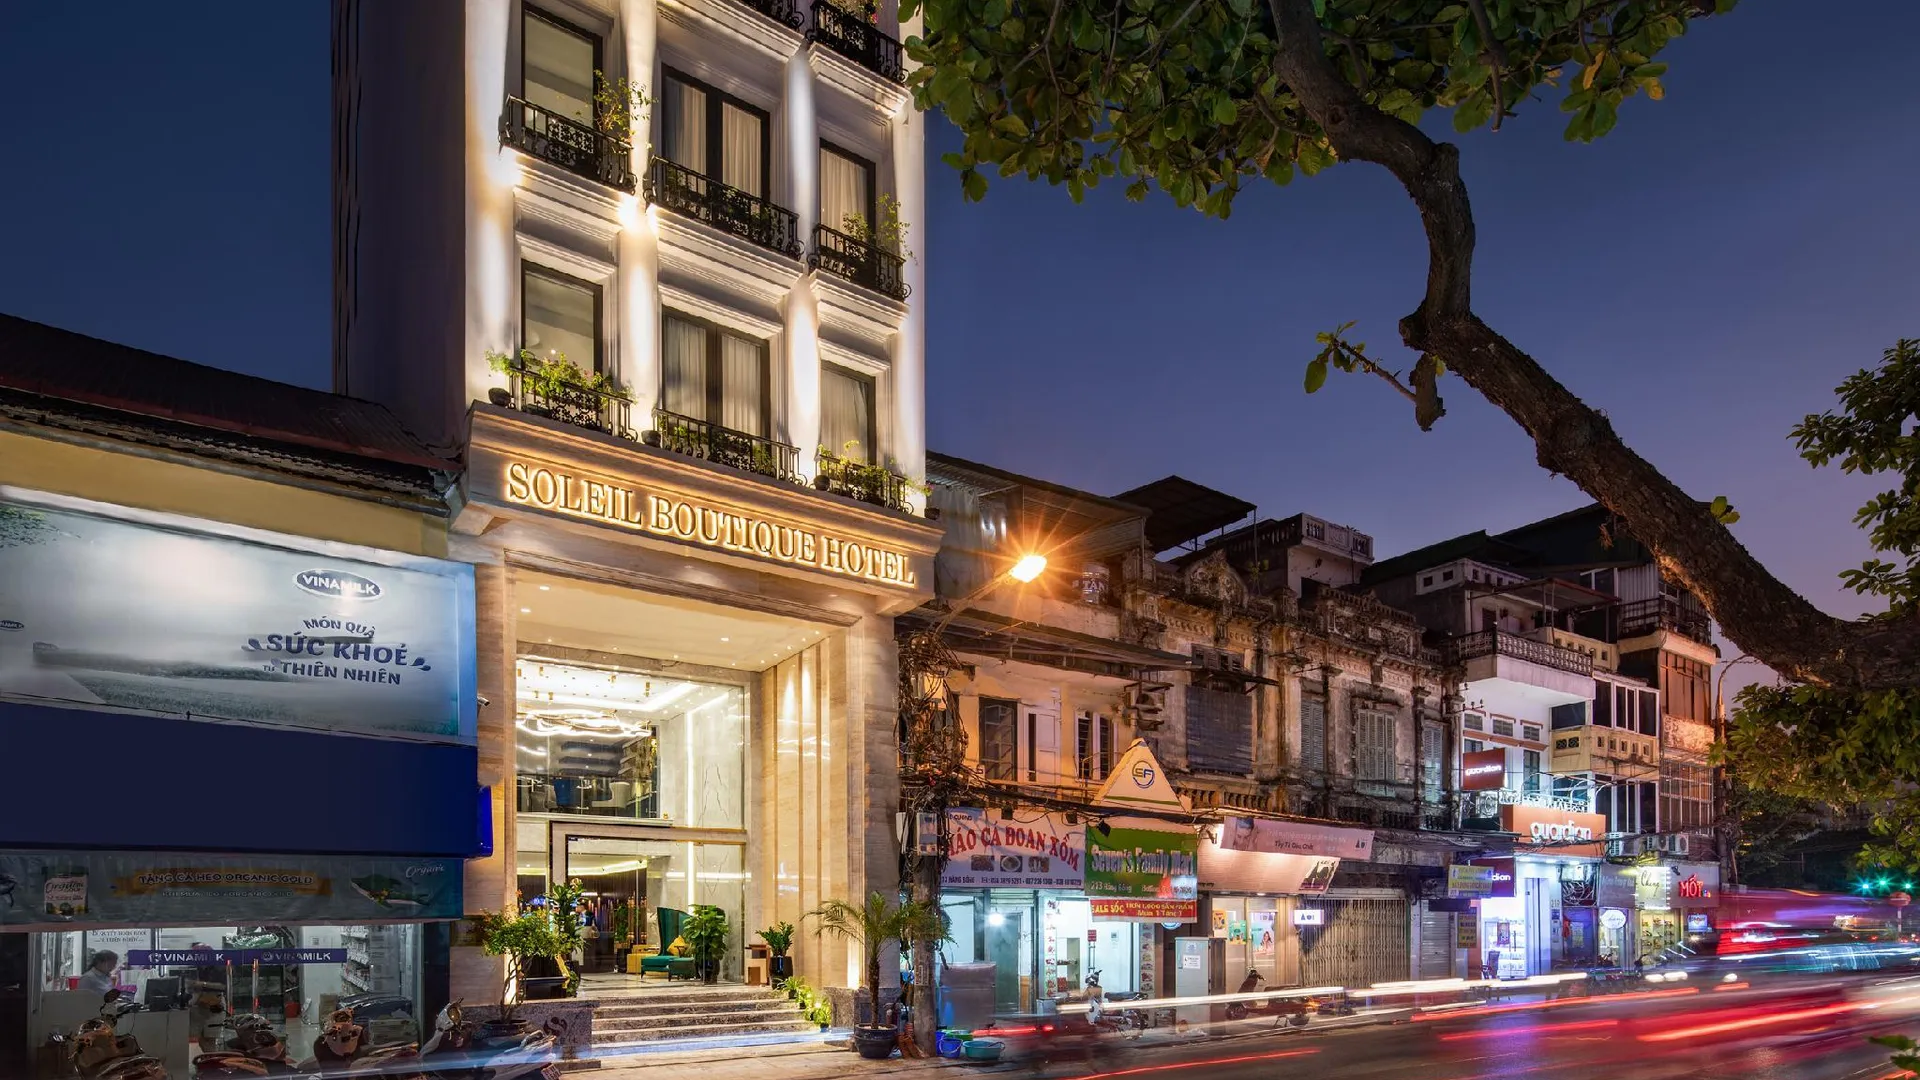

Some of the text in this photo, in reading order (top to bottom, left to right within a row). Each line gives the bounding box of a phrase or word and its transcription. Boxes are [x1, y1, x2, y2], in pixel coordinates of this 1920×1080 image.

[508, 462, 916, 586] SOLEIL BOUTIQUE HOTEL
[302, 573, 377, 596] VINAMILK
[302, 616, 376, 639] MÓN QUÀ
[266, 631, 325, 656] SỨC
[280, 661, 338, 679] THIÊN
[343, 668, 401, 685] NHIÊN
[1465, 764, 1502, 776] guardian
[981, 821, 1002, 847] CÁ
[1005, 826, 1046, 852] ĐOAN
[1530, 820, 1592, 843] guardian
[164, 953, 224, 961] VINAMIK
